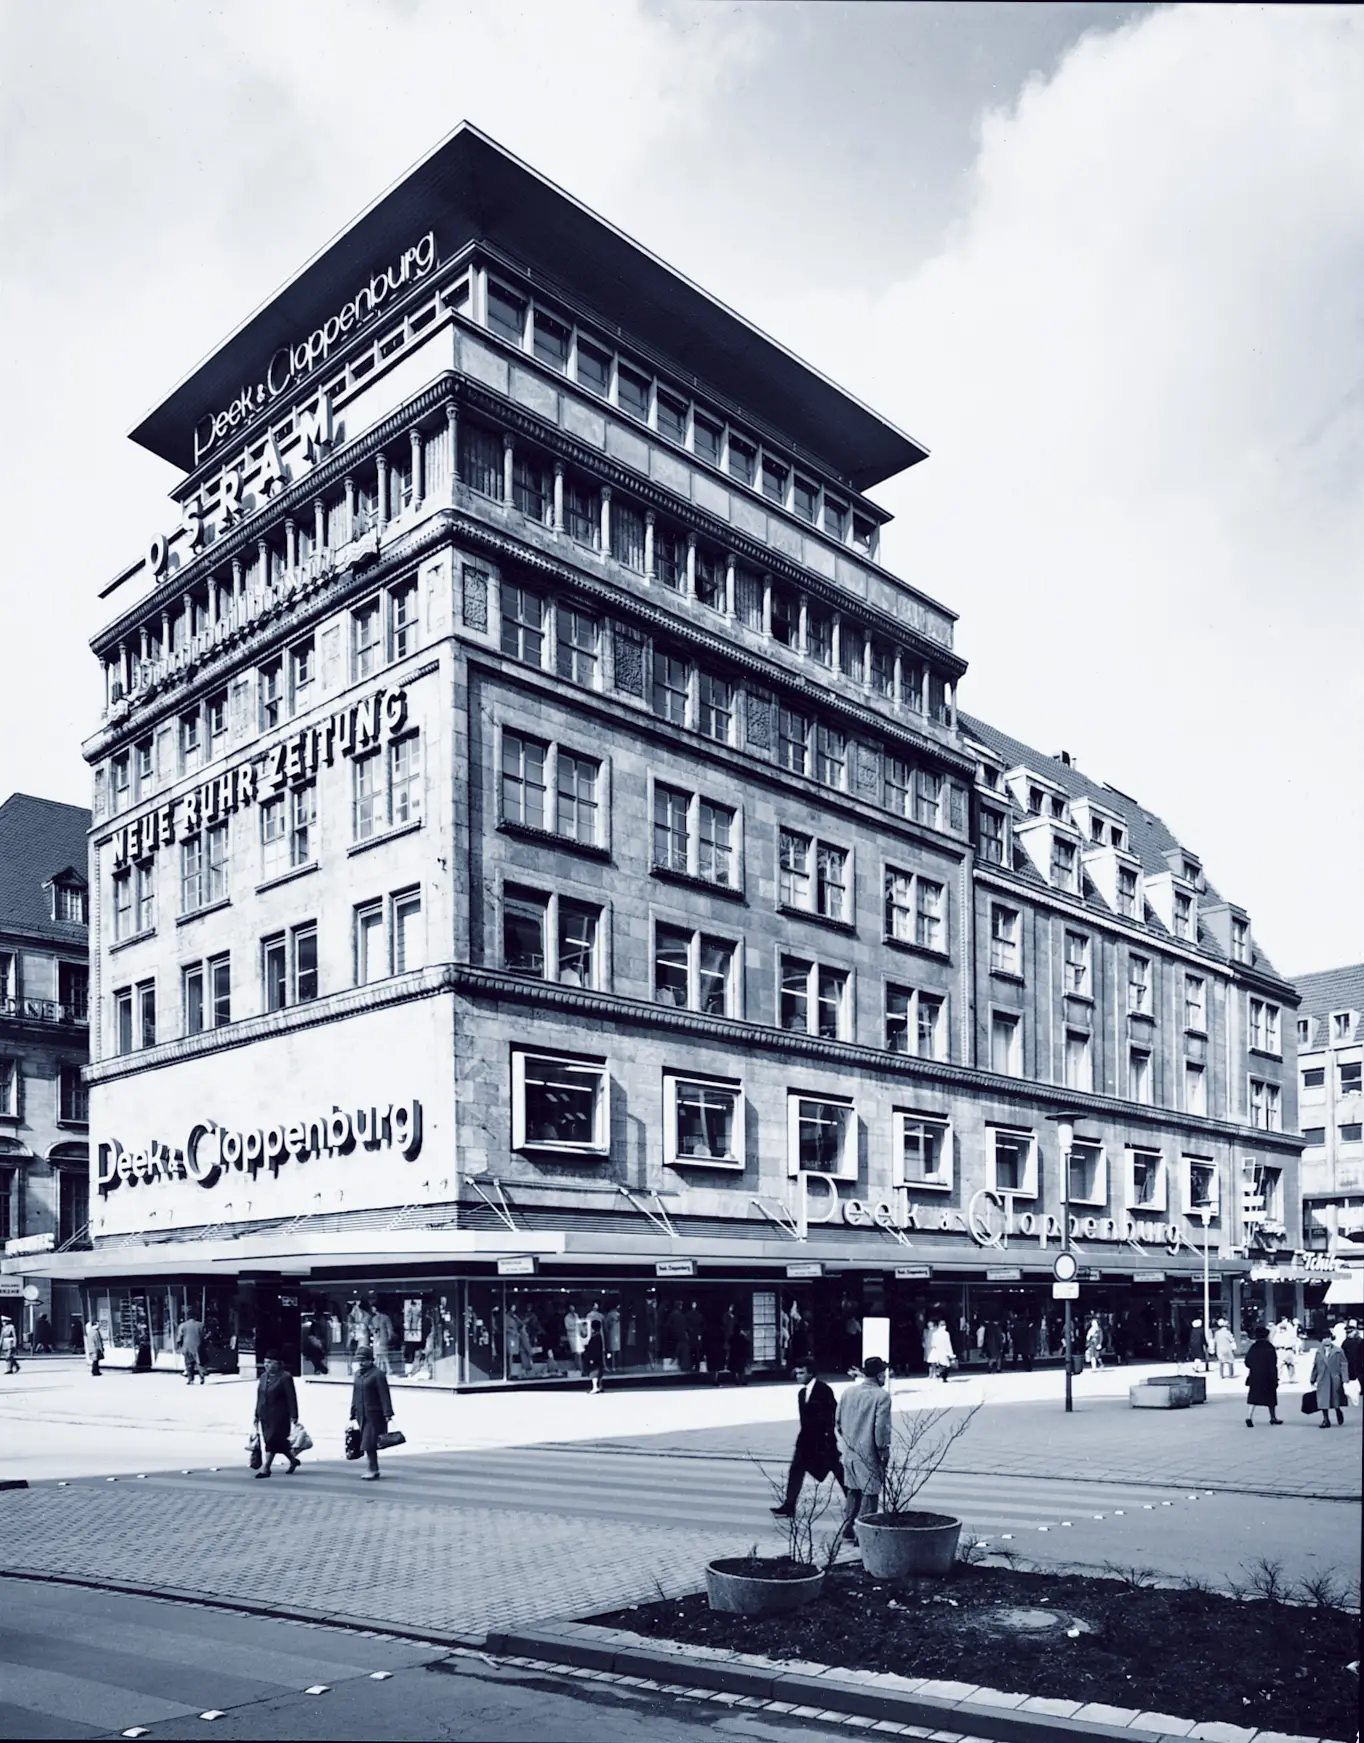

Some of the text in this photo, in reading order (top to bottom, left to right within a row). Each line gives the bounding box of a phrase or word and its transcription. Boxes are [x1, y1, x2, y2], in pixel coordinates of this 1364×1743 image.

[194, 385, 256, 467] Peek
[267, 231, 435, 397] Cloppenburg
[150, 384, 334, 578] OSRAM
[112, 685, 408, 866] NEUE RUHR ZEITUNG
[96, 1138, 165, 1196] Peek
[183, 1099, 421, 1183] Cloppenburg
[798, 1170, 920, 1242] Peek
[968, 1188, 1181, 1255] Cloppenburg
